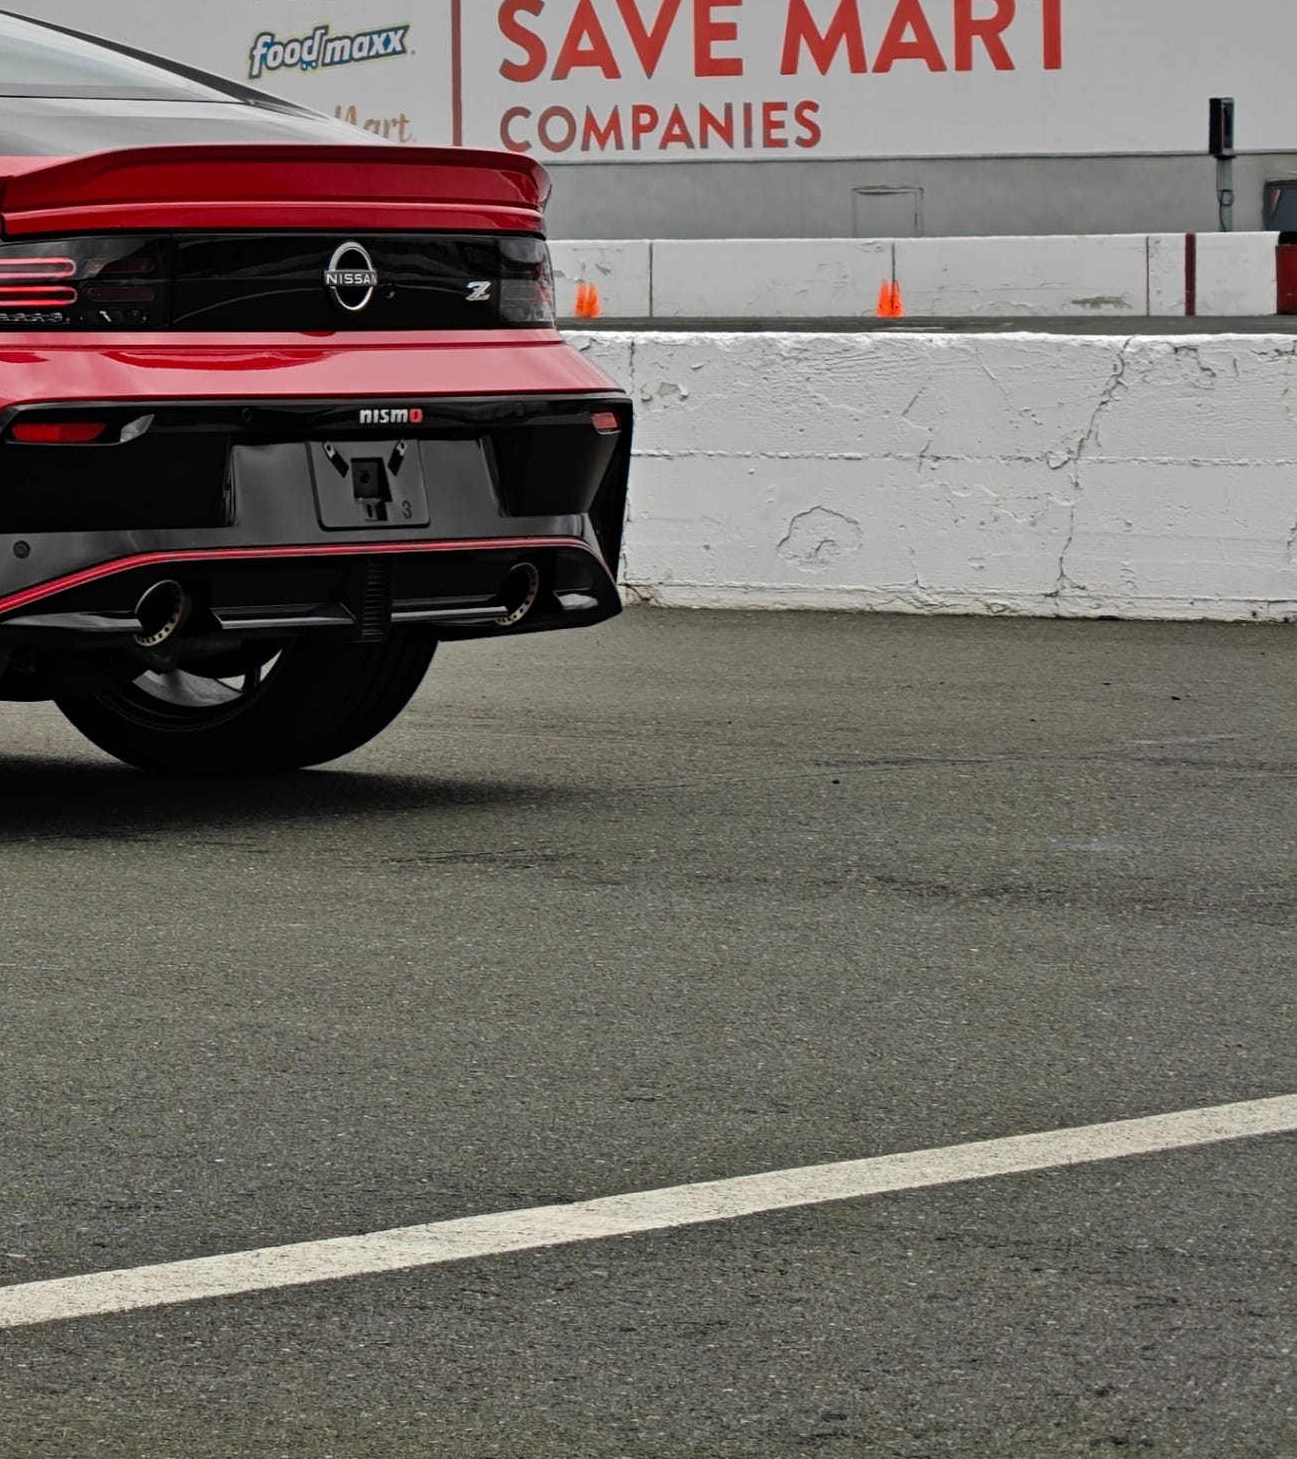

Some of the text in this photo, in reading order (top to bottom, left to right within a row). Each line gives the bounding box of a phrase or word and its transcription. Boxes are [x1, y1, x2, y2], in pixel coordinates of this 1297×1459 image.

[499, 100, 822, 153] COMPANIES
[325, 273, 377, 285] NISSAN
[466, 280, 491, 301] Z
[359, 408, 423, 424] nismo
